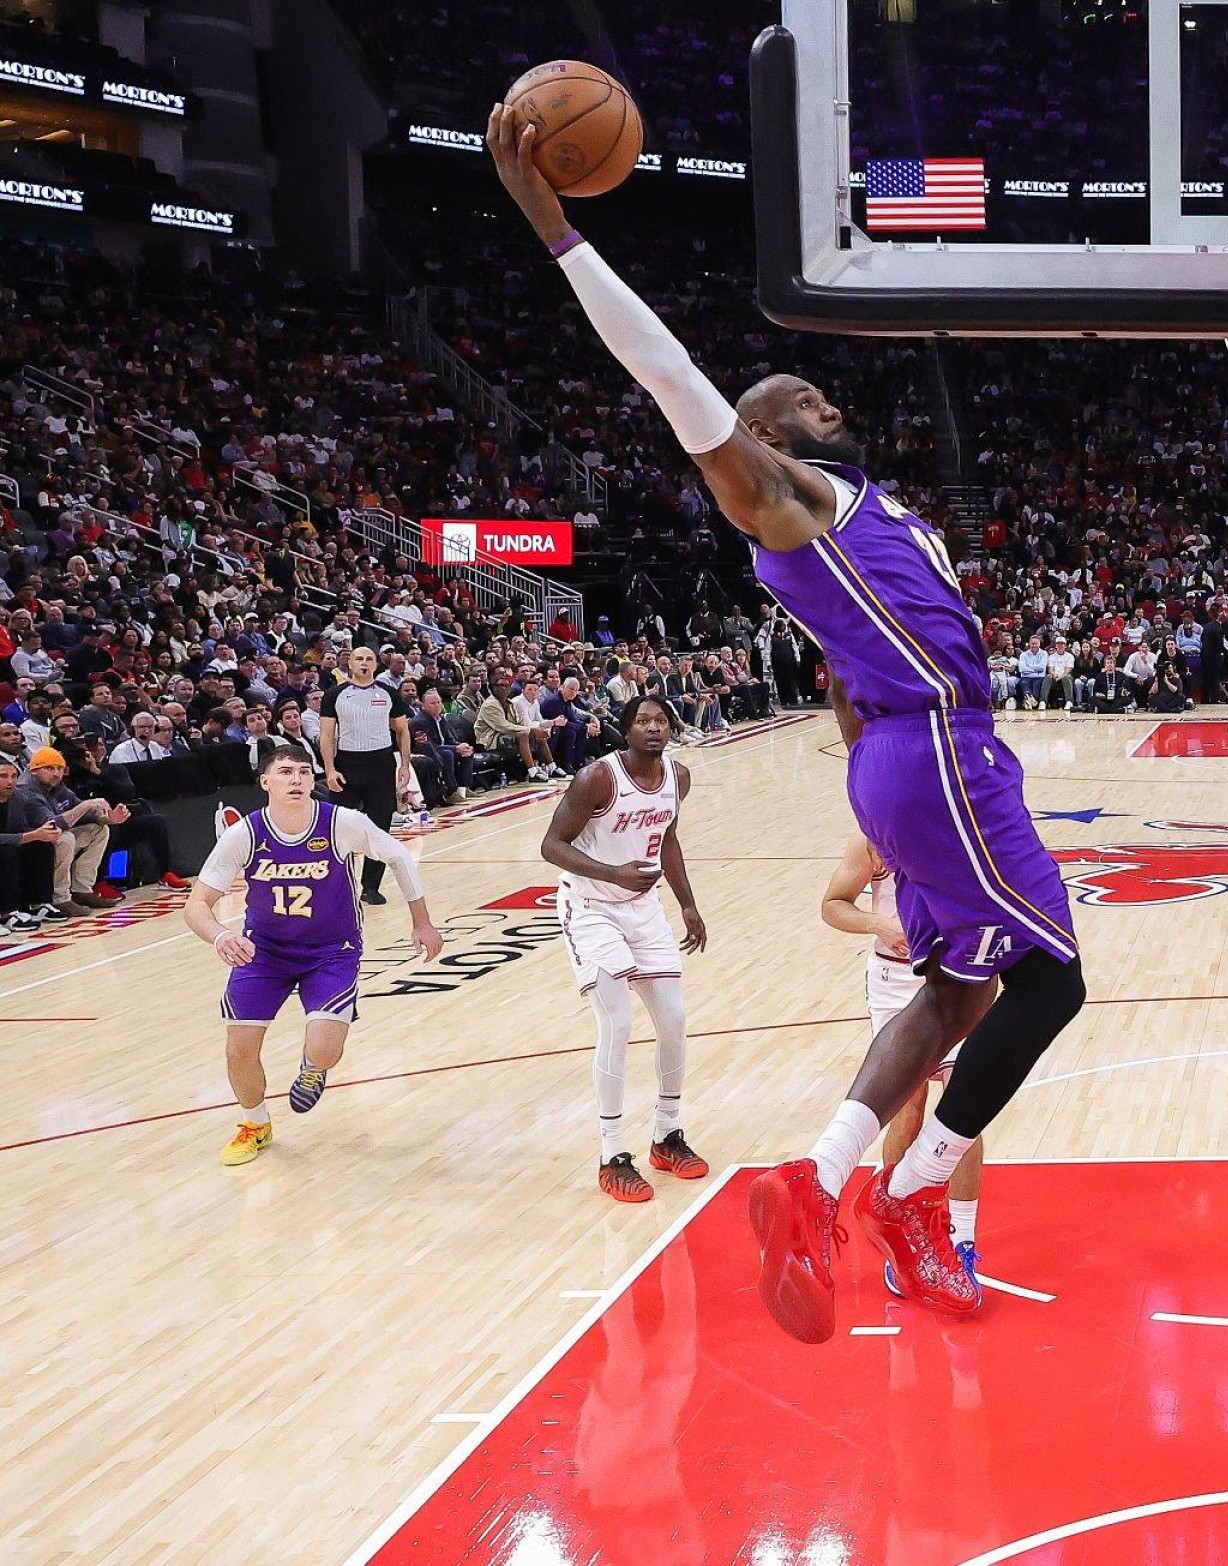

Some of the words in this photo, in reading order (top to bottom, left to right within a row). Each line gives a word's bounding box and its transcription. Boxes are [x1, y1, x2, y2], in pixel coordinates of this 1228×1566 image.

[102, 81, 186, 108] MORTON'S
[408, 125, 485, 146] MORTON'S
[677, 156, 747, 174] MORTON'S
[1004, 180, 1070, 192] MORTON'S
[1082, 181, 1147, 193] MORTON'S
[151, 202, 234, 226] MORTON'S
[483, 534, 556, 553] TUNDRA
[250, 858, 330, 881] LAKERS
[271, 885, 313, 918] 12
